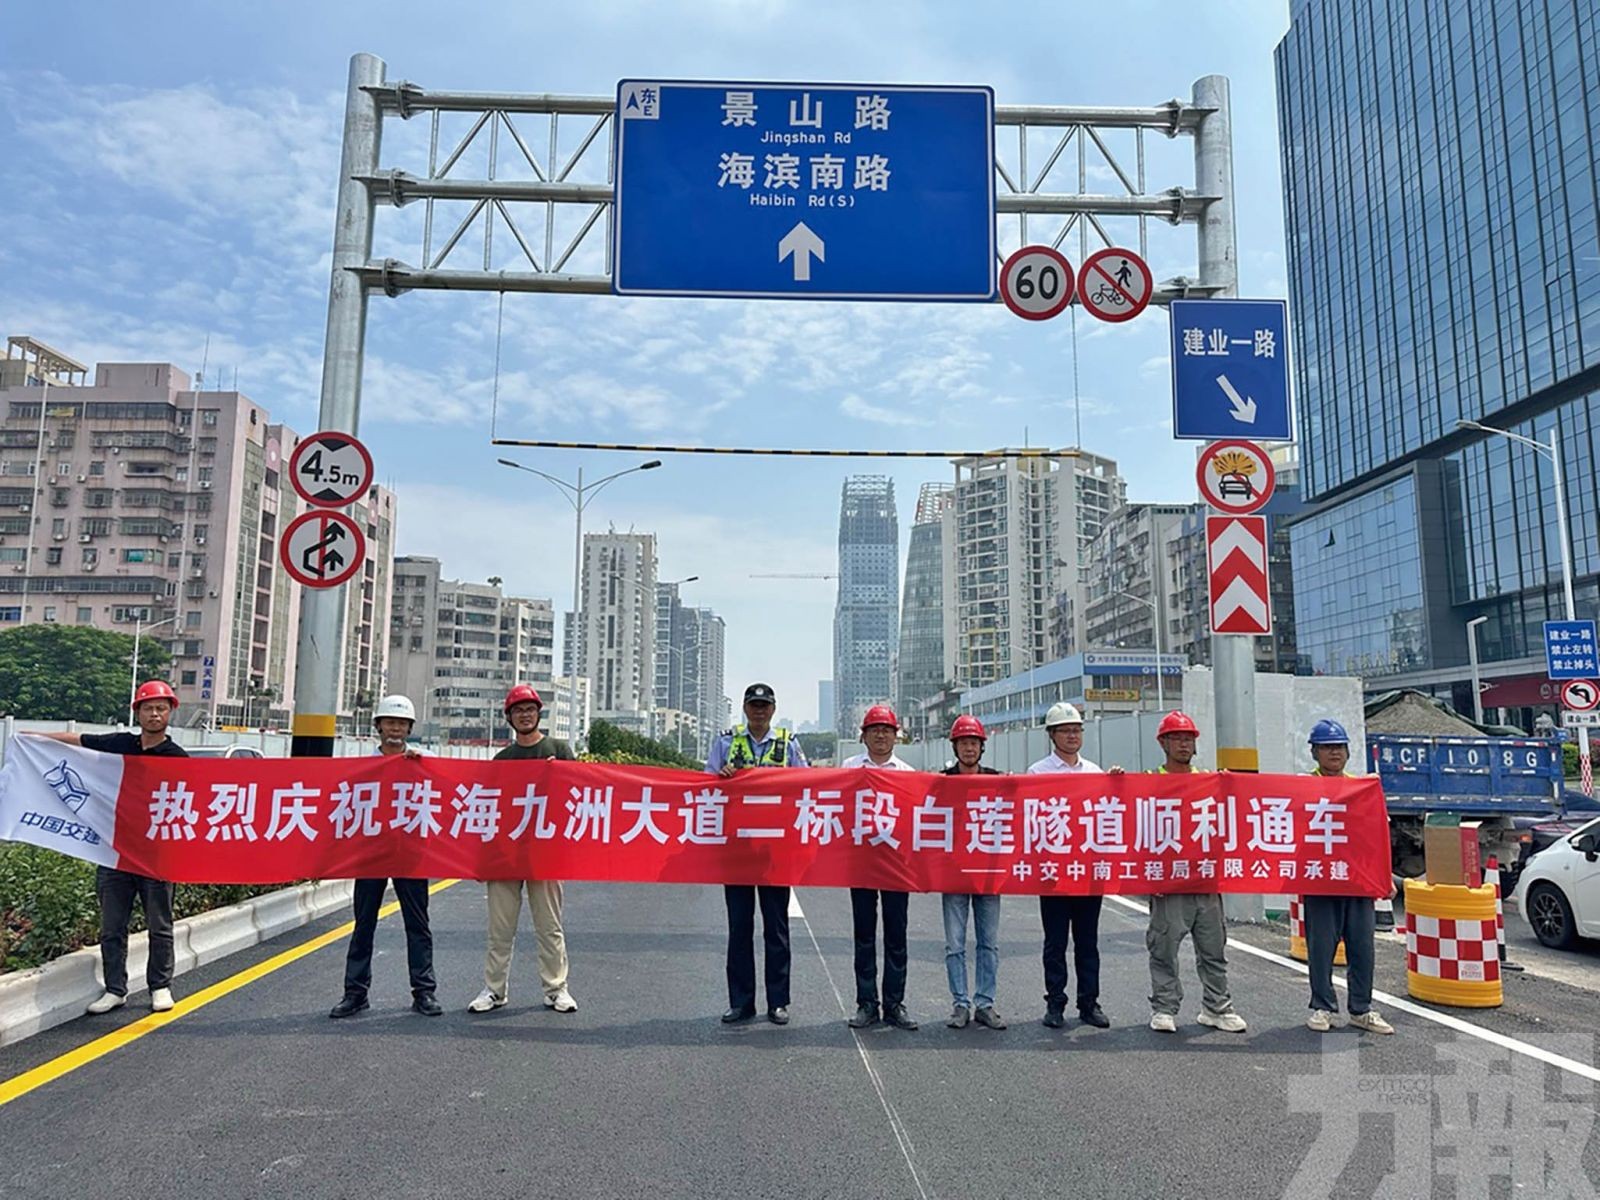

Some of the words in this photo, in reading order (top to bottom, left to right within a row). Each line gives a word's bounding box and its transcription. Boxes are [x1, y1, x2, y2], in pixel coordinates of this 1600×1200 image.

[641, 88, 657, 104] 东
[644, 105, 652, 116] E
[721, 91, 891, 131] 景山路
[760, 131, 826, 146] Jingshan
[834, 131, 851, 144] Rd
[717, 152, 892, 192] 海滨南路
[750, 194, 796, 206] Haibin
[808, 195, 855, 208] Rd(S)
[1016, 265, 1058, 299] 60
[1183, 328, 1276, 358] 建业一路
[301, 450, 360, 486] 4.5m
[1549, 629, 1591, 641] 建业一路
[1551, 644, 1593, 655] 禁止左转
[1553, 659, 1595, 670] 禁止掉头
[146, 781, 1348, 856] 热烈庆祝珠海九洲大道二标段白莲隧道顺利通车
